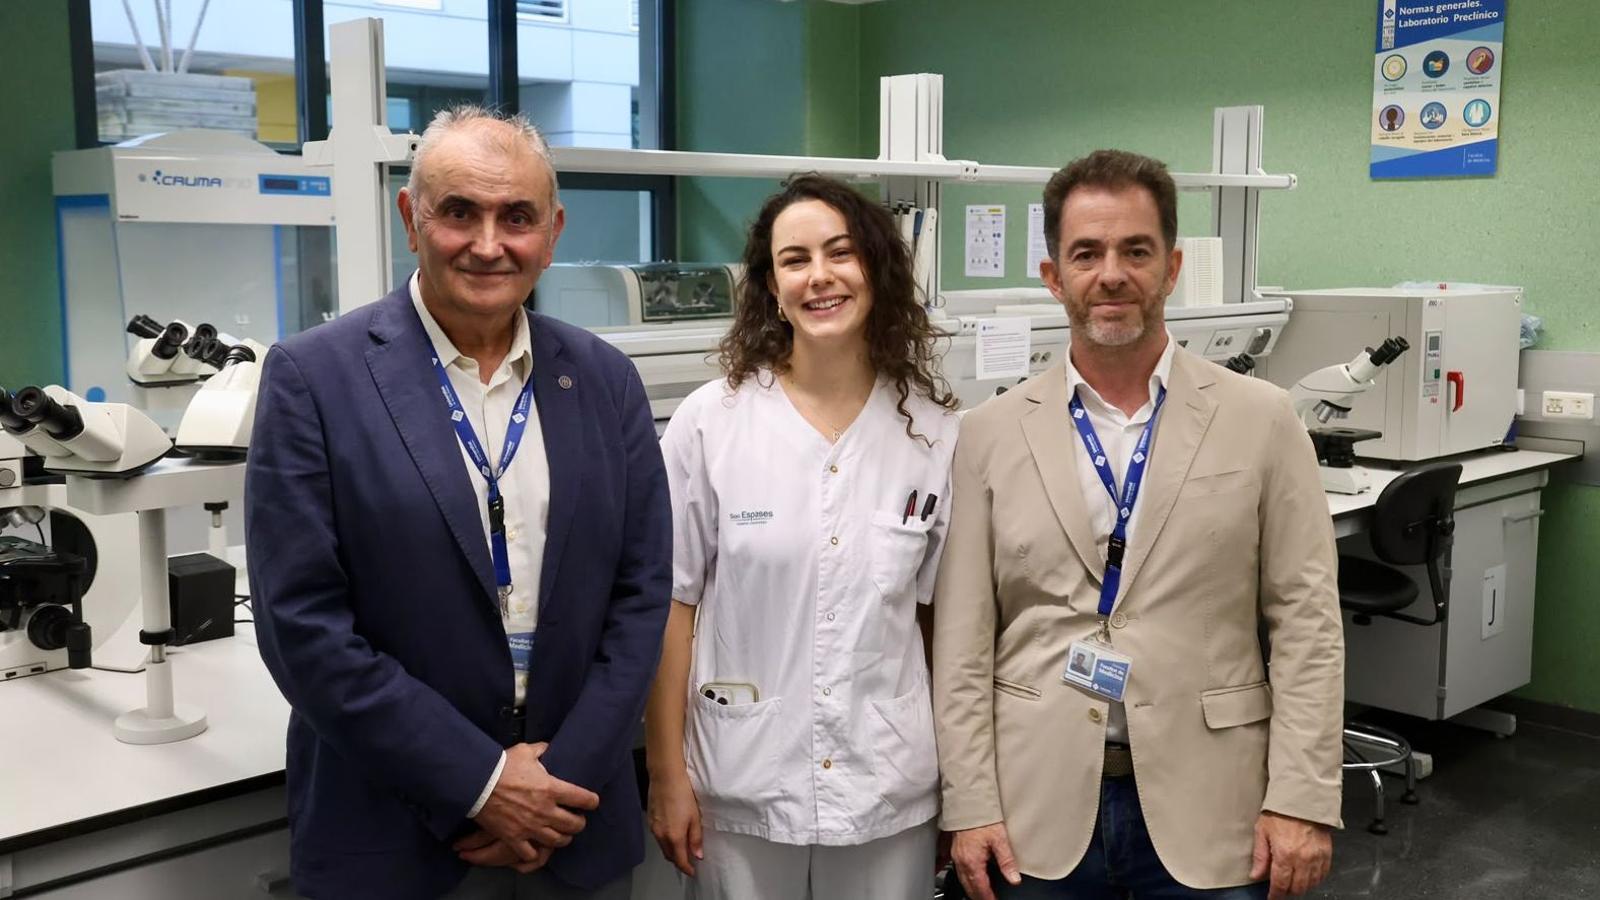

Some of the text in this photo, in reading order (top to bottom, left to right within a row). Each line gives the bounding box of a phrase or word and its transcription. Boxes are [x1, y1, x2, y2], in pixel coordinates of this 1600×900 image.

[1399, 0, 1483, 16] Normas generales.
[1398, 10, 1499, 28] Laboratorio Preclínico
[741, 511, 773, 522] Espases
